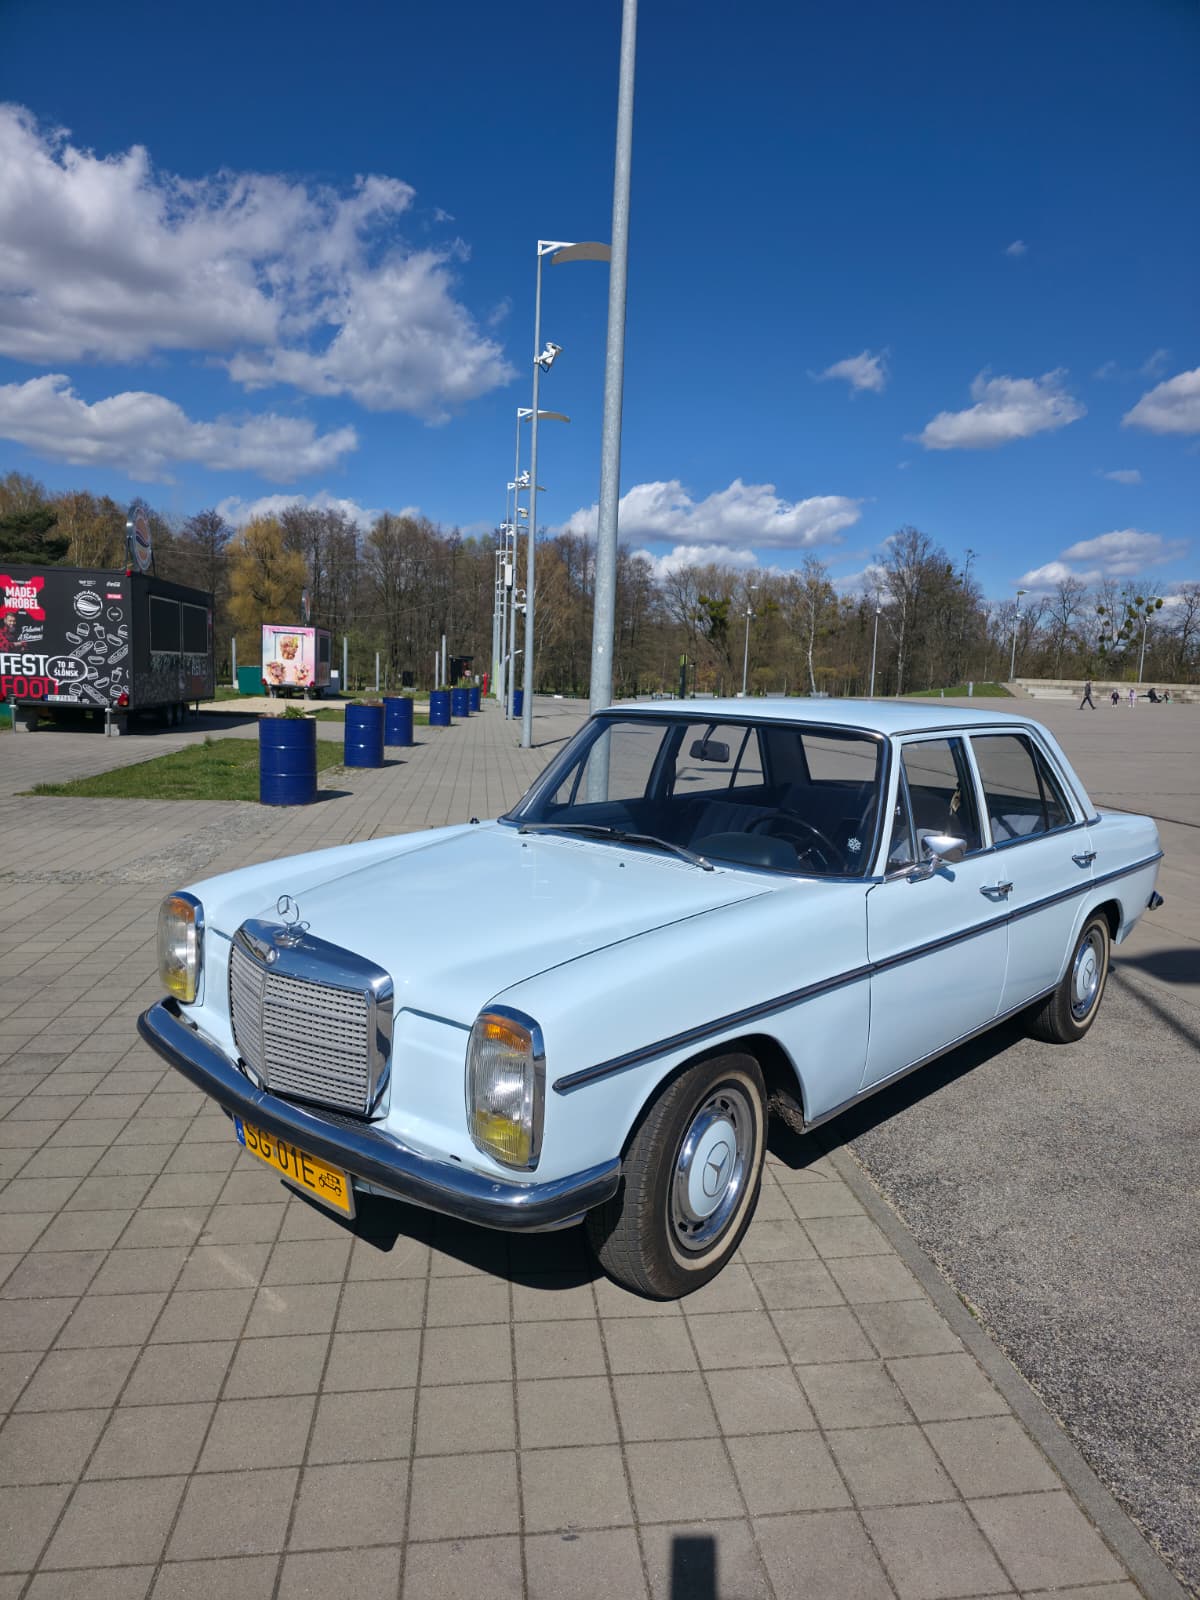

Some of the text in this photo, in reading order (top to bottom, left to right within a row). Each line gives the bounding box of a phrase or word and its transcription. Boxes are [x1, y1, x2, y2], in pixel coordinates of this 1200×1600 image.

[5, 586, 37, 598] MADEJ
[0, 652, 49, 676] FEST
[56, 660, 66, 668] TO
[245, 1120, 316, 1188] SG 01E
